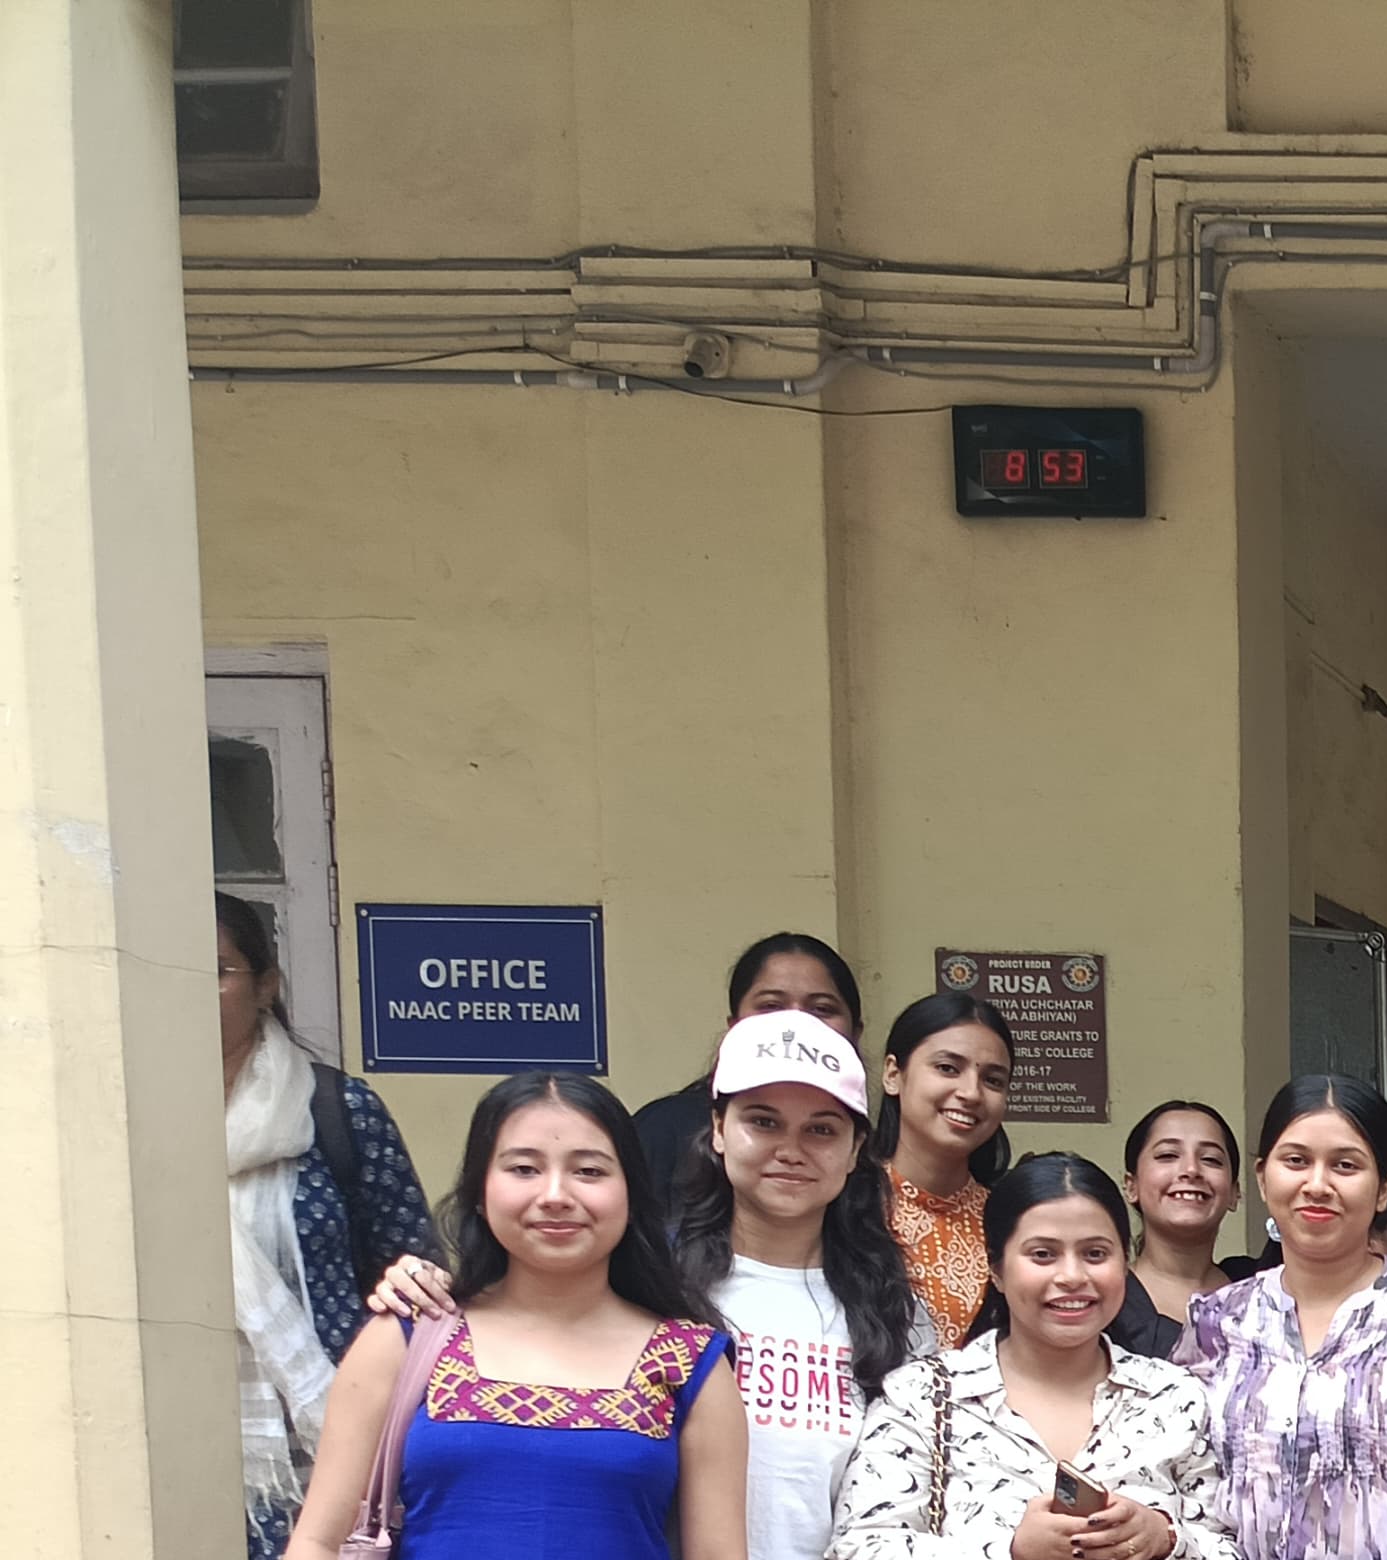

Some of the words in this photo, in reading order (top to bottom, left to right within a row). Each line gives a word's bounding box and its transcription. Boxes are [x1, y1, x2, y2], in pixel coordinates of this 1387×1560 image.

[1005, 451, 1026, 482] 8
[1043, 452, 1084, 482] 53
[988, 960, 1023, 969] PROJECT
[419, 958, 547, 990] OFFICE
[988, 975, 1052, 994] RUSA
[1021, 999, 1094, 1010] UCHCHATAR
[388, 1000, 451, 1020] NAAC
[458, 1001, 512, 1021] PEER
[518, 1002, 581, 1022] TEAM
[1020, 1010, 1077, 1023] ABHIYAN)
[1040, 1030, 1083, 1042] GRANTS
[1085, 1031, 1099, 1042] TO
[756, 1028, 841, 1073] KING
[1046, 1047, 1095, 1059] COLLEGE
[1012, 1065, 1052, 1077] 2016-17
[1009, 1082, 1024, 1091] OF
[1026, 1083, 1045, 1091] THE
[1046, 1083, 1077, 1092] WORK
[1034, 1105, 1050, 1113] SIDE
[1062, 1106, 1096, 1114] COLLEGE
